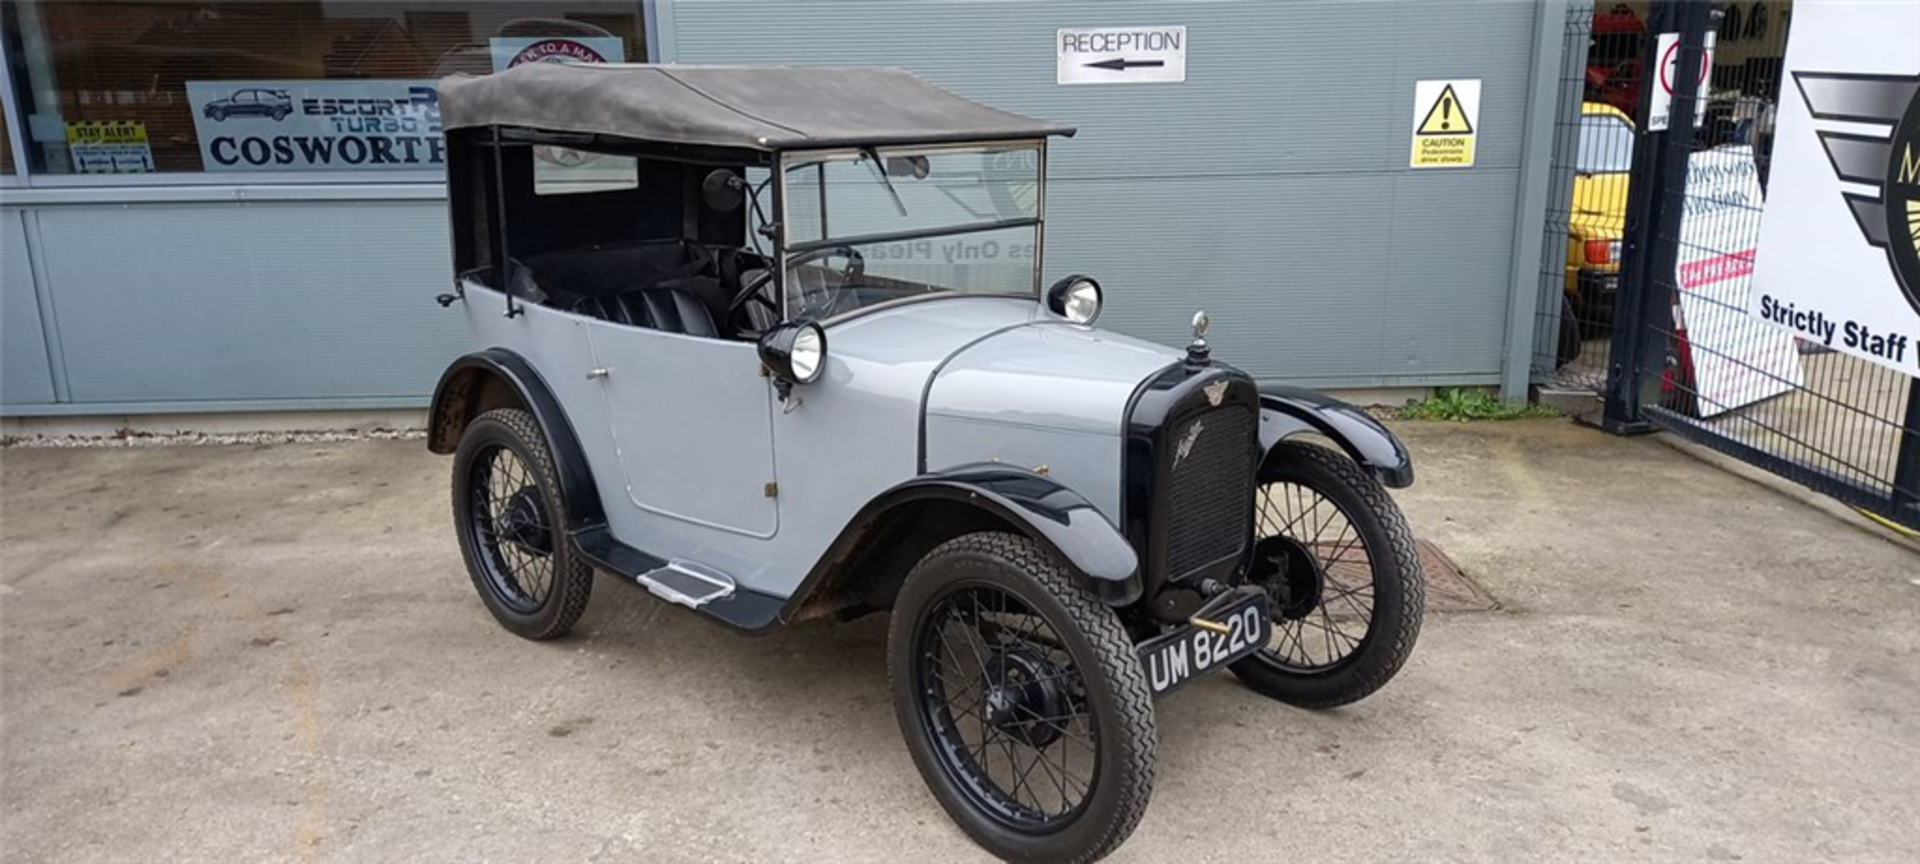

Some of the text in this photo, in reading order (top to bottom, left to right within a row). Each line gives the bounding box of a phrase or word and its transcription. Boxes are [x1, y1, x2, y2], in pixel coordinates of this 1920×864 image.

[1063, 31, 1180, 52] RECEPTION
[303, 99, 409, 116] ESCORT
[331, 116, 417, 133] TURBO
[1651, 115, 1668, 126] SPE
[76, 127, 136, 139] STAY ALERT
[1422, 138, 1465, 147] CAUTION
[1761, 294, 1836, 346] Strictly
[1843, 320, 1908, 363] Staff
[1150, 606, 1261, 692] UM 8220
